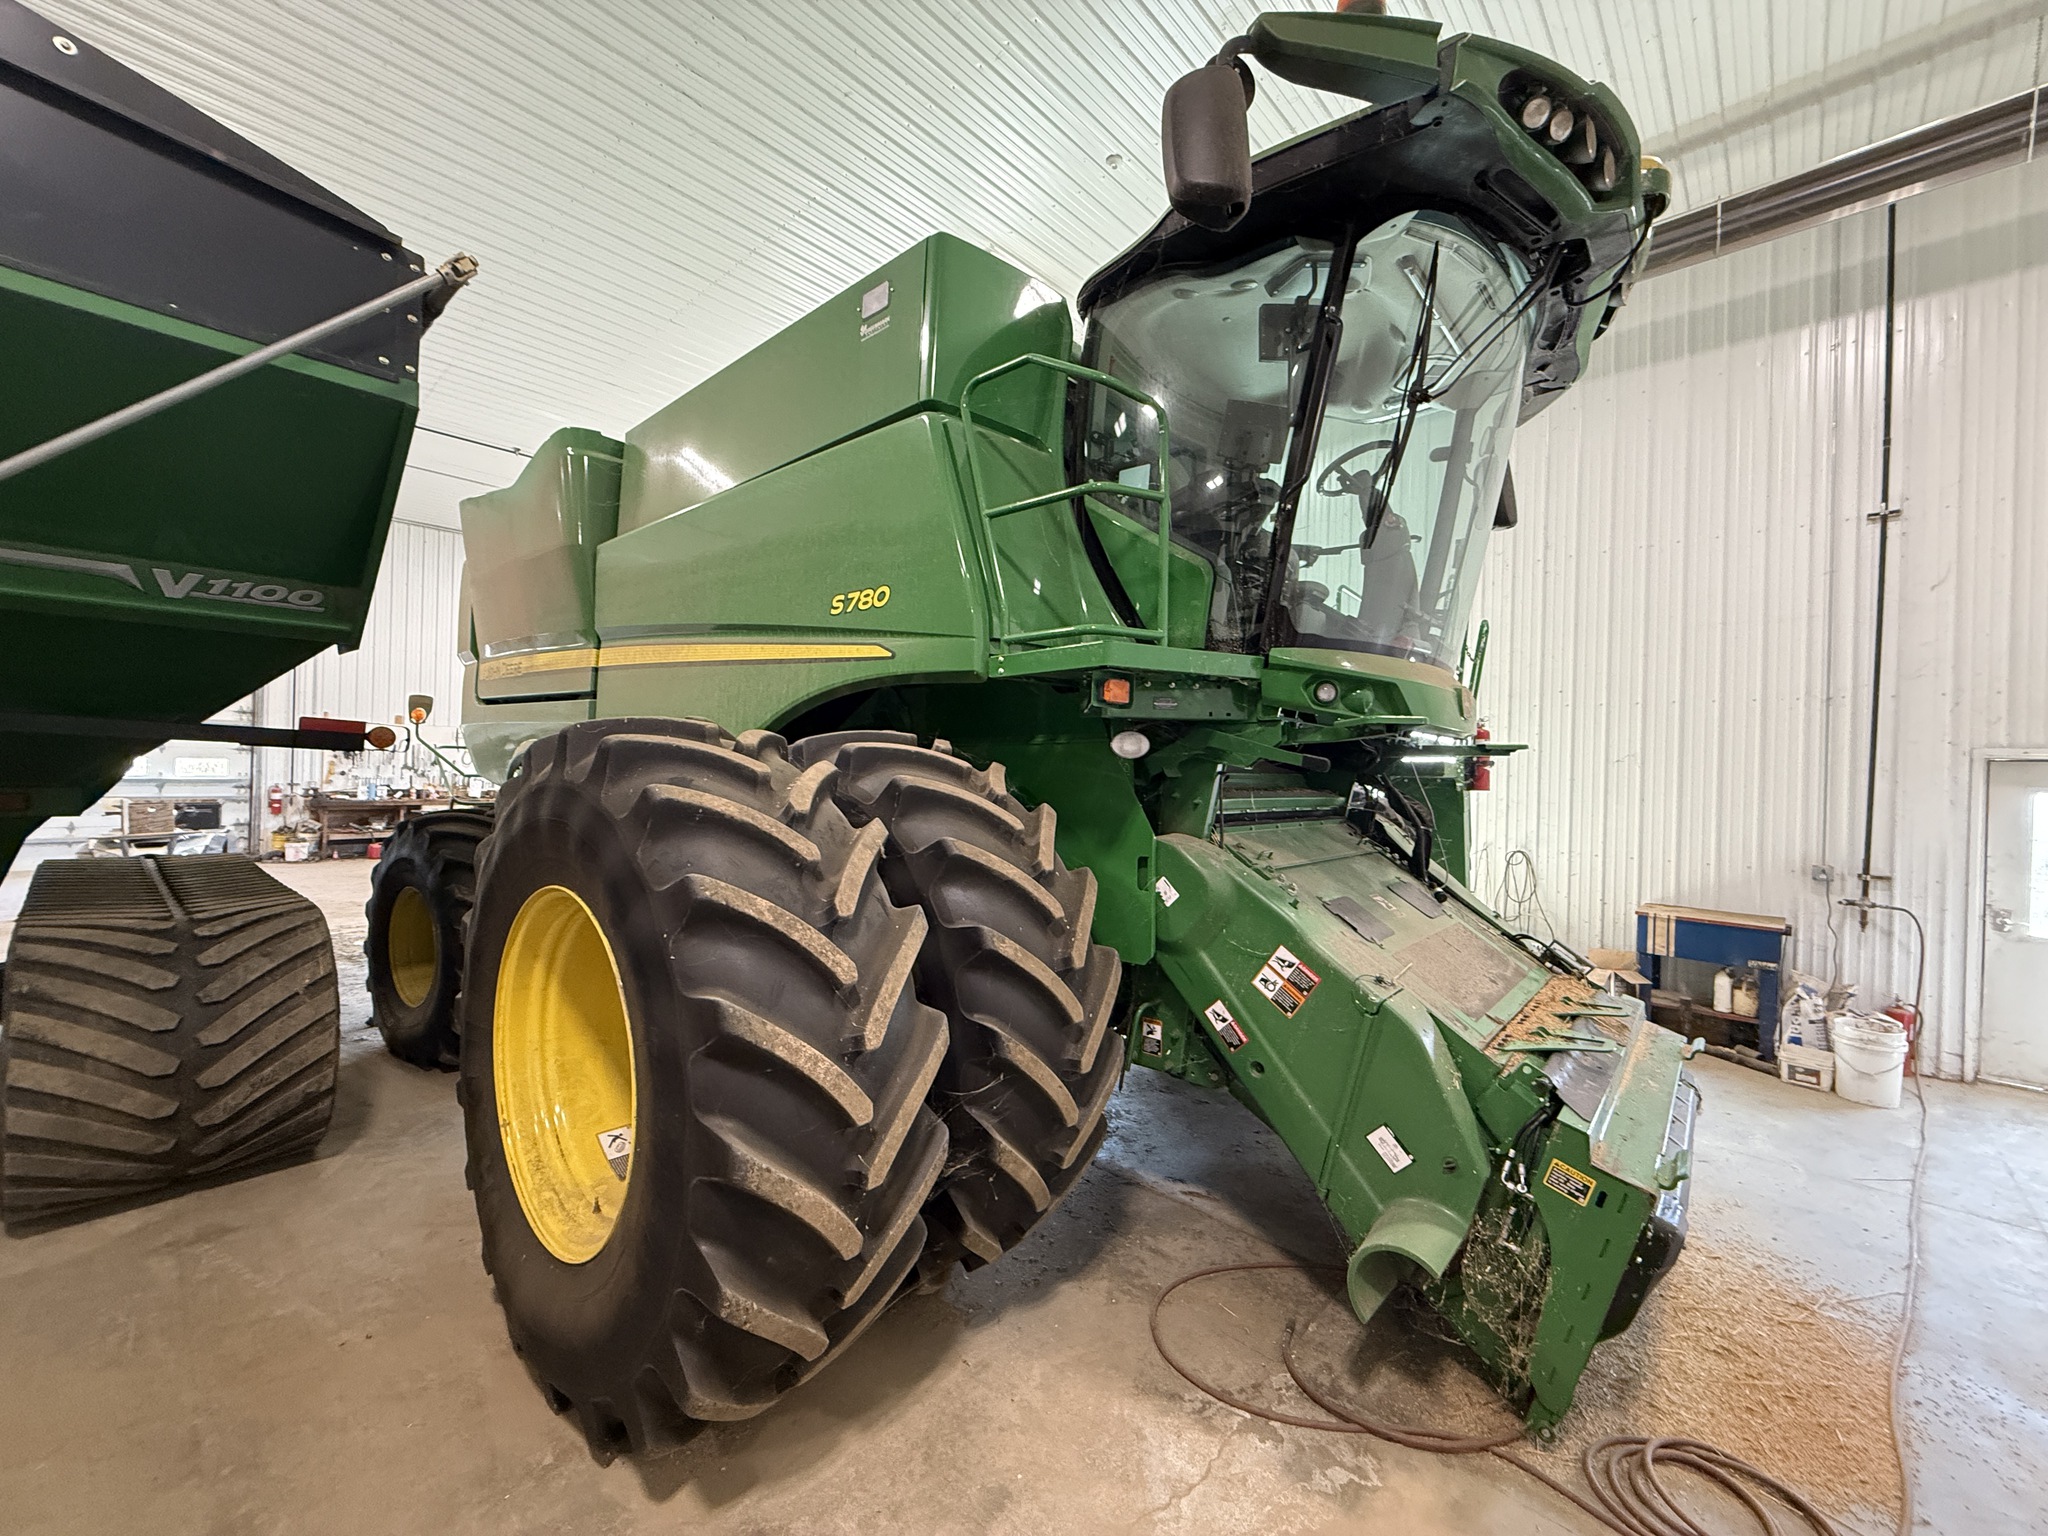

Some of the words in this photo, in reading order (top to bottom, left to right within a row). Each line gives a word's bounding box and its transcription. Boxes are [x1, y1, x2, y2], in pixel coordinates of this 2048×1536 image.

[152, 568, 325, 606] V1100
[829, 585, 891, 615] S780
[1559, 1163, 1594, 1186] CAUTION
